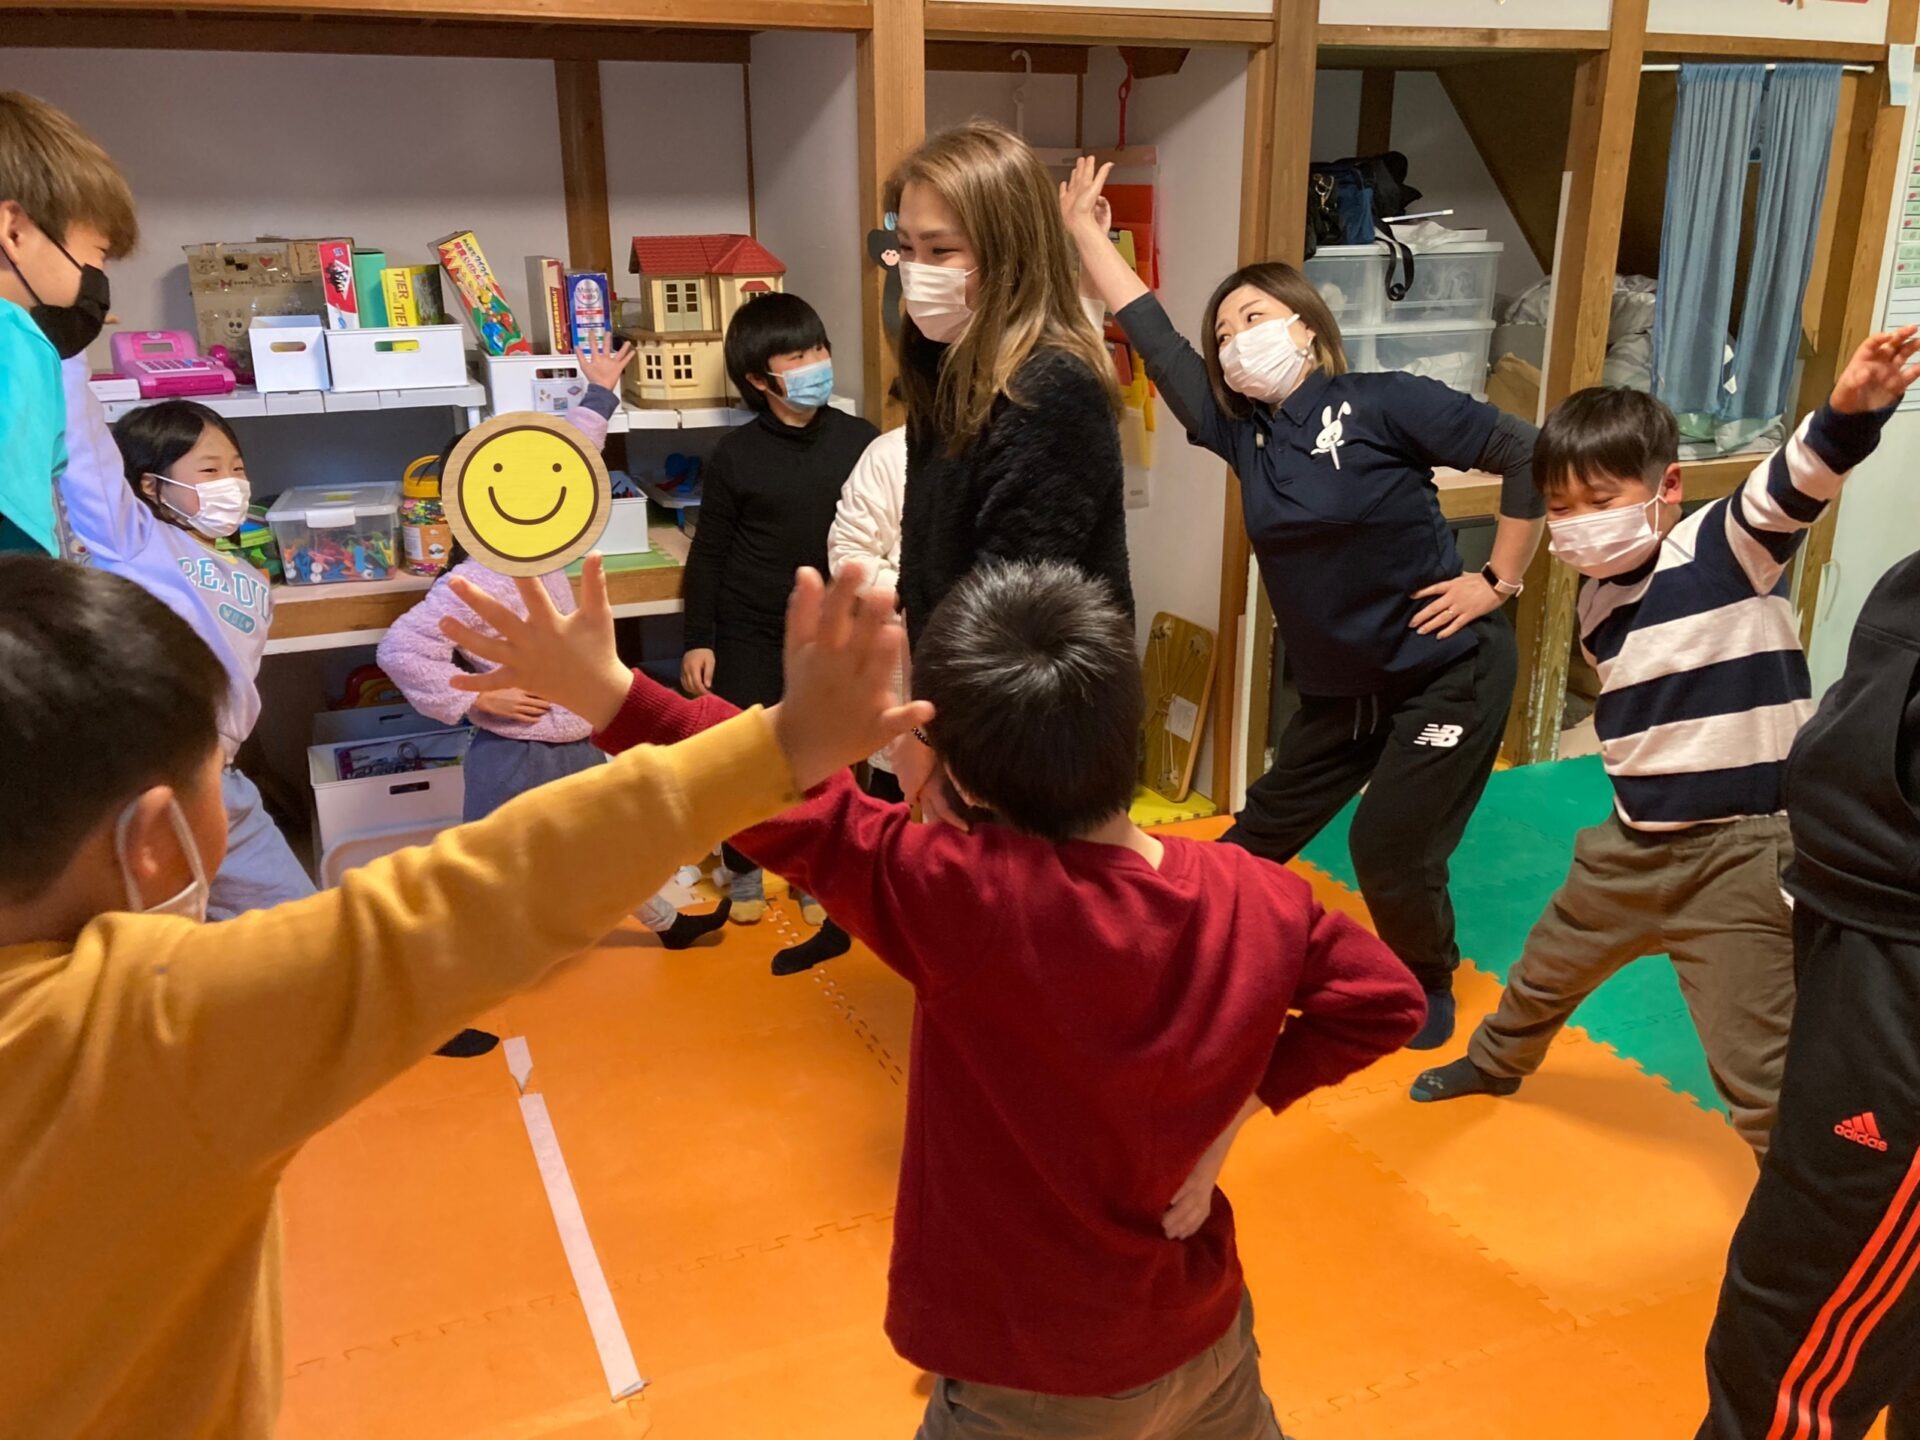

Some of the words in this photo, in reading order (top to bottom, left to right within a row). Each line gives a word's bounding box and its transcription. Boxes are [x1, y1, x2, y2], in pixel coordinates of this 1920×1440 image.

[393, 270, 410, 299] TIER
[1413, 723, 1463, 747] NB
[1834, 1124, 1888, 1151] adidas
